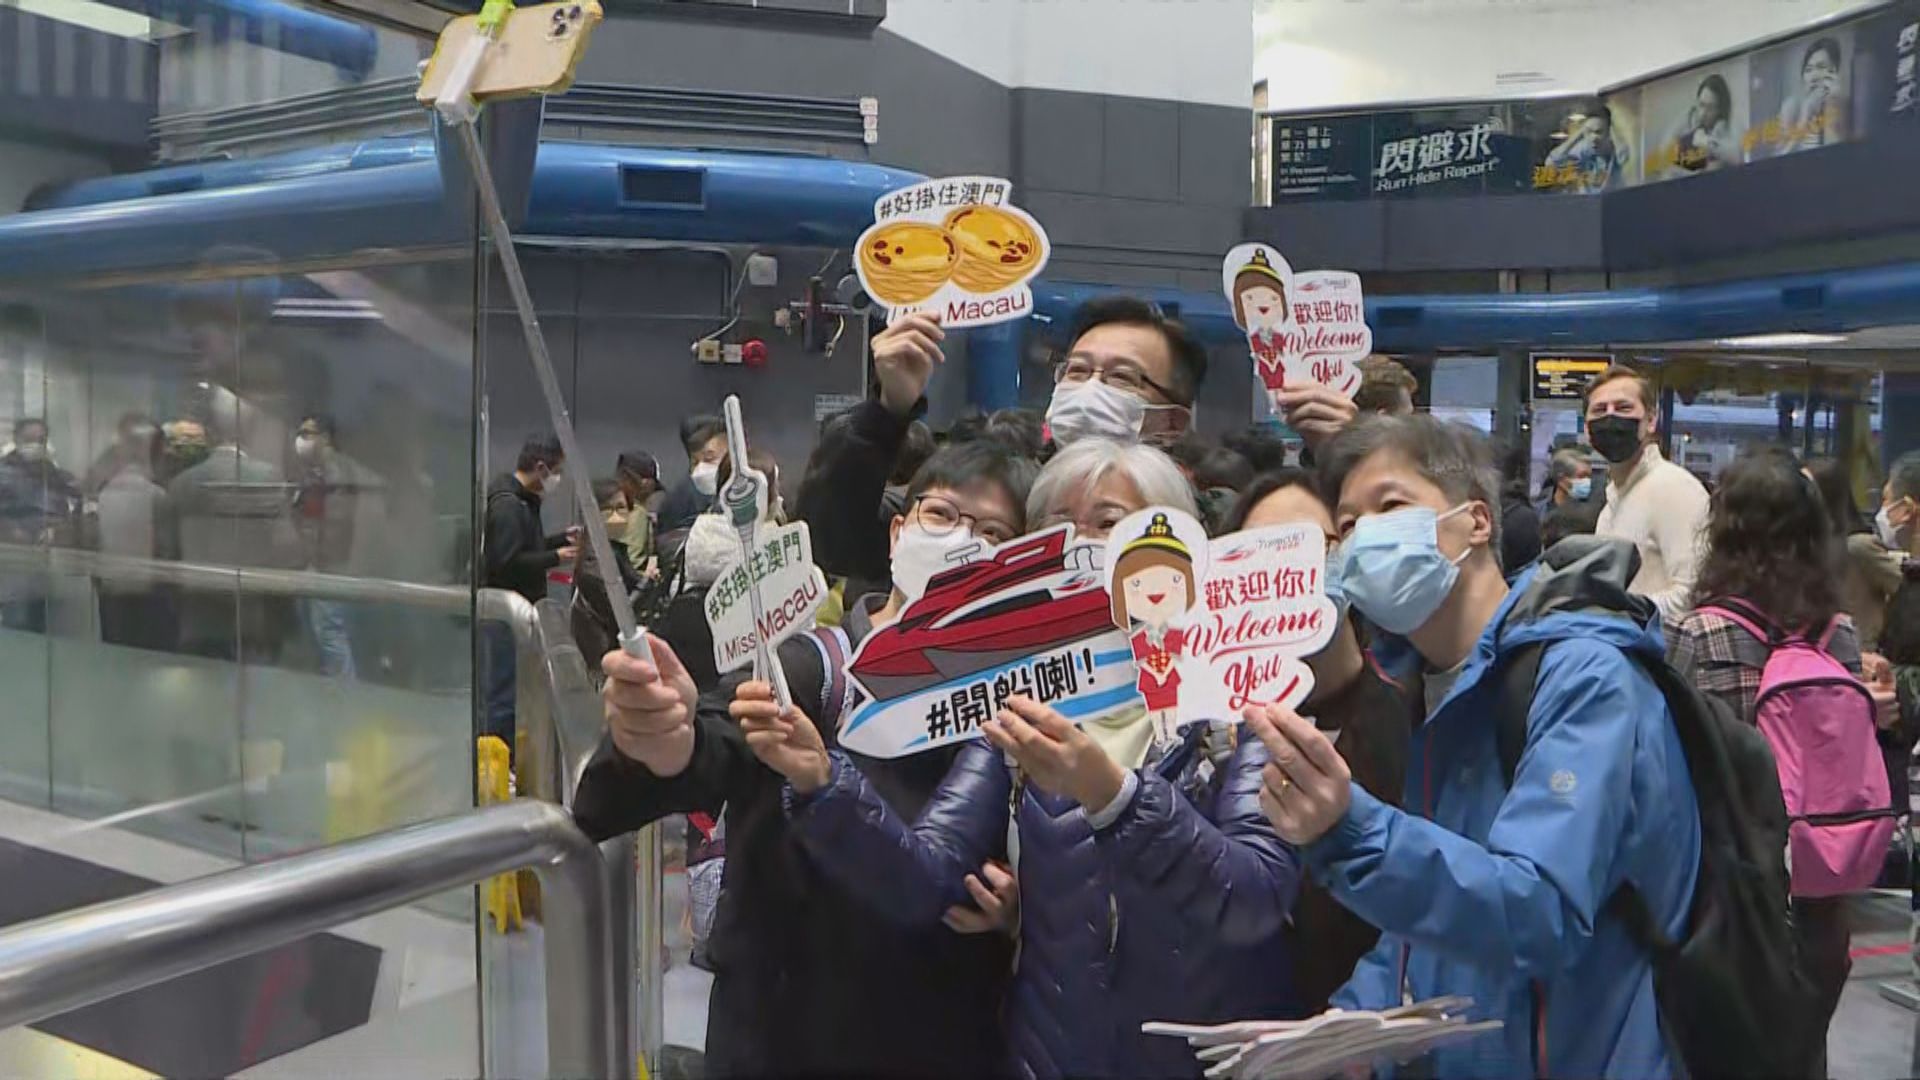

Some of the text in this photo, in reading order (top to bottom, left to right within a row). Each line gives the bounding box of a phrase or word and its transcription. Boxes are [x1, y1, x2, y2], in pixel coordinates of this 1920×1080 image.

[1374, 123, 1492, 177] 閃避求
[1376, 178, 1407, 191] Run
[1408, 170, 1441, 186] Hide
[1444, 157, 1500, 179] Report
[879, 181, 1006, 219] #好掛住澳門
[946, 290, 1026, 323] Macau
[1293, 300, 1359, 325] 歡迎你!
[1284, 326, 1366, 357] Welcome
[1311, 358, 1343, 385] You
[709, 531, 802, 623] #好掛住澳門
[1204, 567, 1317, 611] 歡迎你!
[717, 574, 819, 666] I Miss Macau
[1183, 608, 1324, 659] Welcome
[1223, 653, 1283, 711] You
